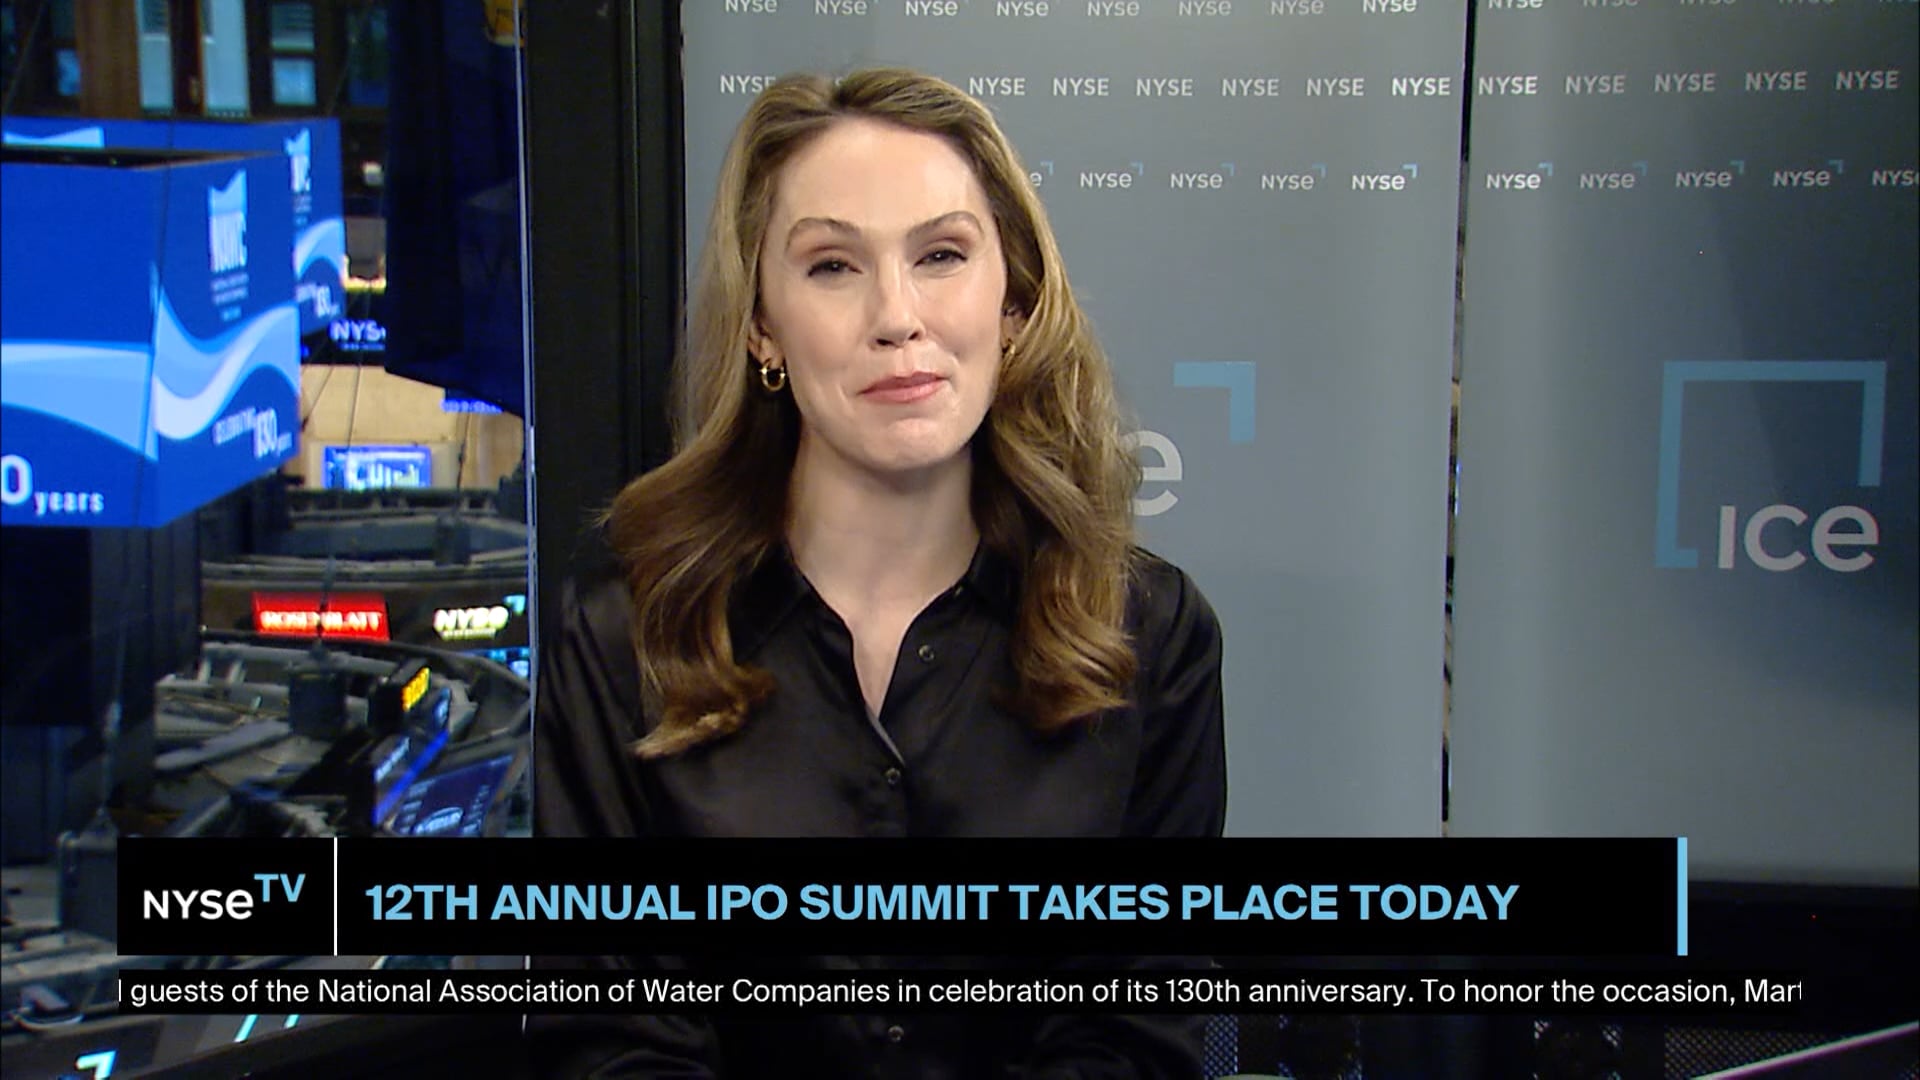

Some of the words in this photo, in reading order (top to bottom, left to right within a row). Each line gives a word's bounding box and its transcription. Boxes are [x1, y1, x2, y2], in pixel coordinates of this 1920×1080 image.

[969, 77, 1025, 96] NYSE
[1053, 77, 1109, 96] NYSE
[1136, 78, 1193, 96] NYSE
[1222, 78, 1279, 97] NYSE
[1307, 77, 1364, 96] NYSE
[1392, 77, 1451, 96] NYSE
[1478, 75, 1538, 95] NYSE
[1565, 74, 1626, 94] NYSE
[1654, 72, 1716, 93] NYSE
[1745, 71, 1808, 91] NYSE
[1835, 69, 1899, 90] NYSE
[1872, 170, 1919, 187] NYS
[330, 319, 386, 341] NYS
[34, 491, 105, 515] years
